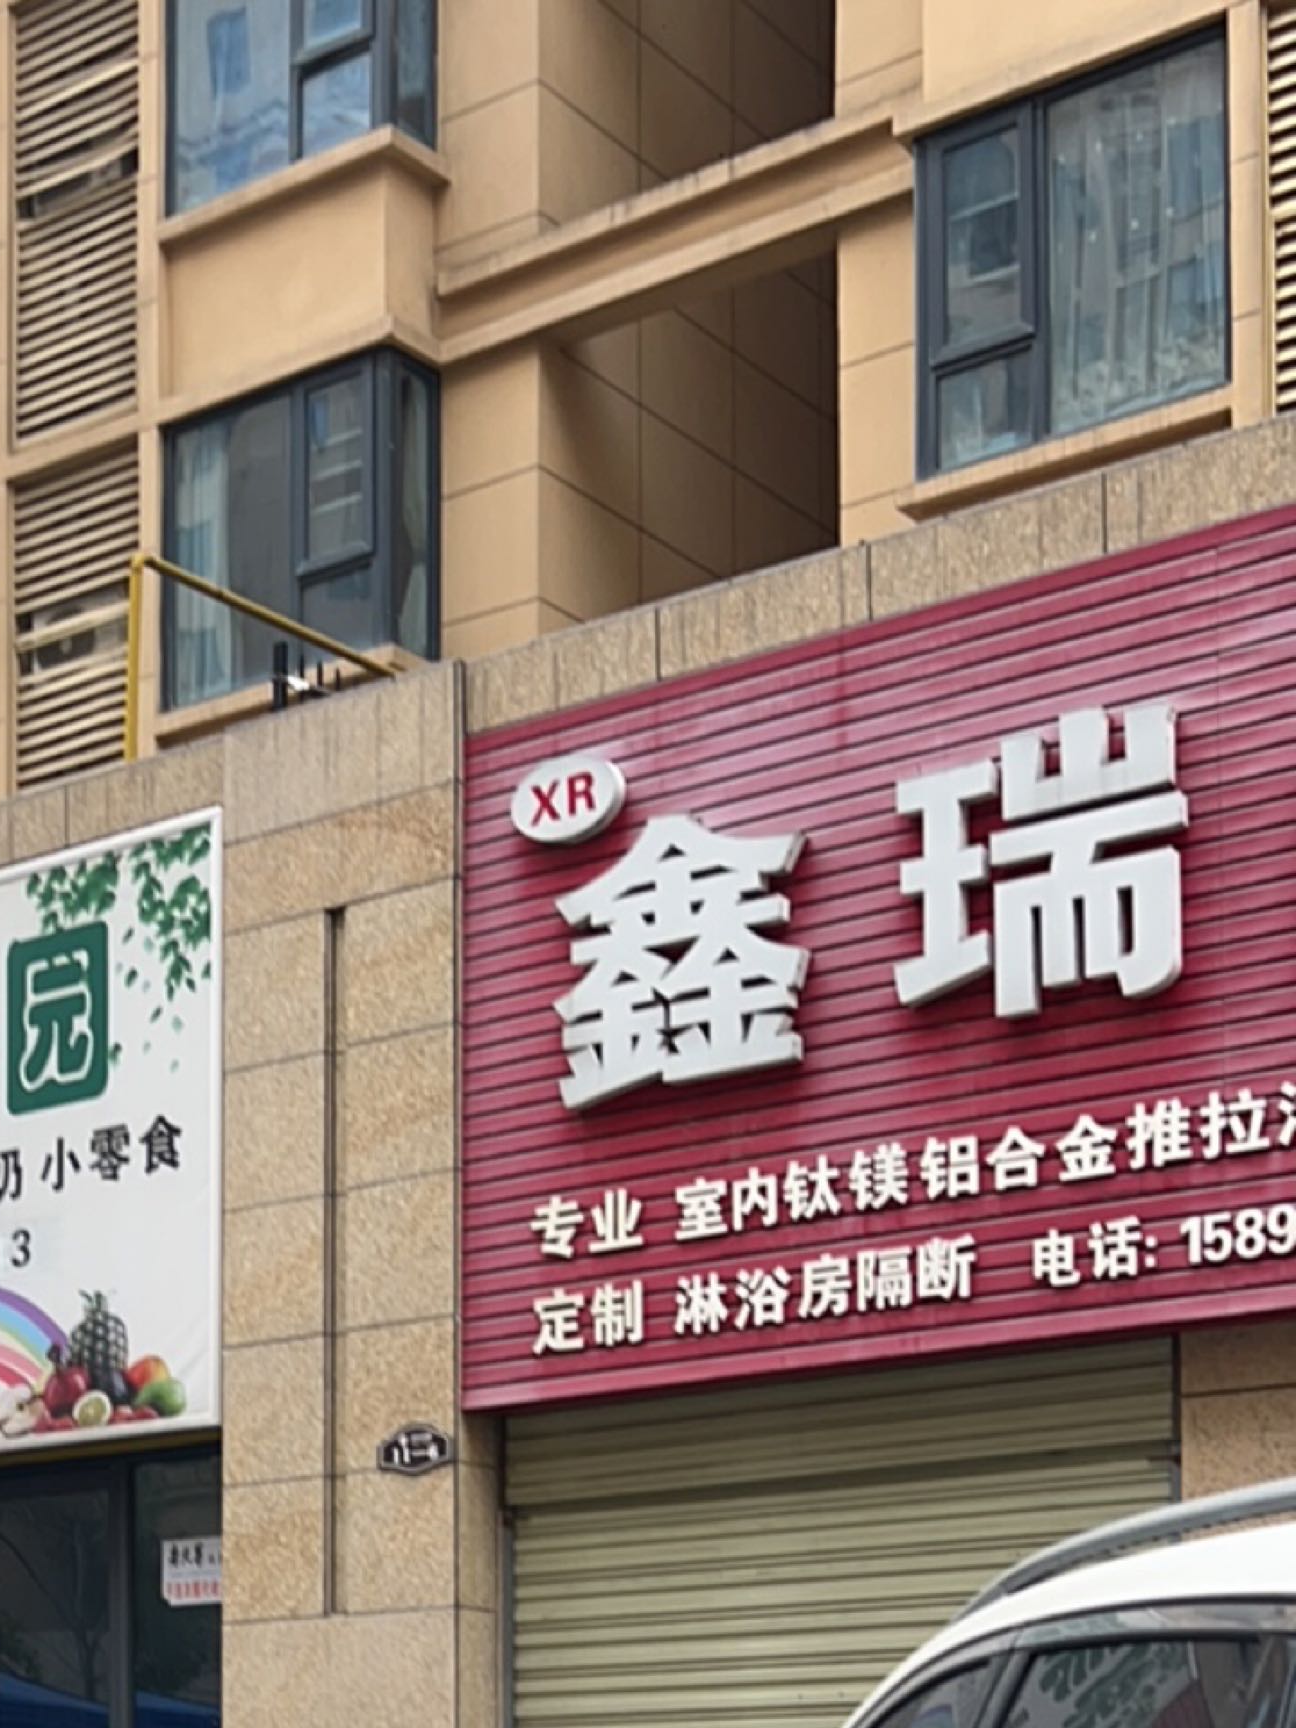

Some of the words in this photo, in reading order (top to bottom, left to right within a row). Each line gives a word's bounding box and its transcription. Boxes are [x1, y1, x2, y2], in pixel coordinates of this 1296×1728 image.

[529, 771, 596, 825] XR
[553, 701, 1191, 1112] 鑫瑞
[39, 1114, 184, 1192] 小零食
[529, 1187, 644, 1260] 专业
[529, 1280, 645, 1357] 定制
[673, 1234, 977, 1337] 淋浴房隔断
[1179, 1202, 1296, 1265] 1589
